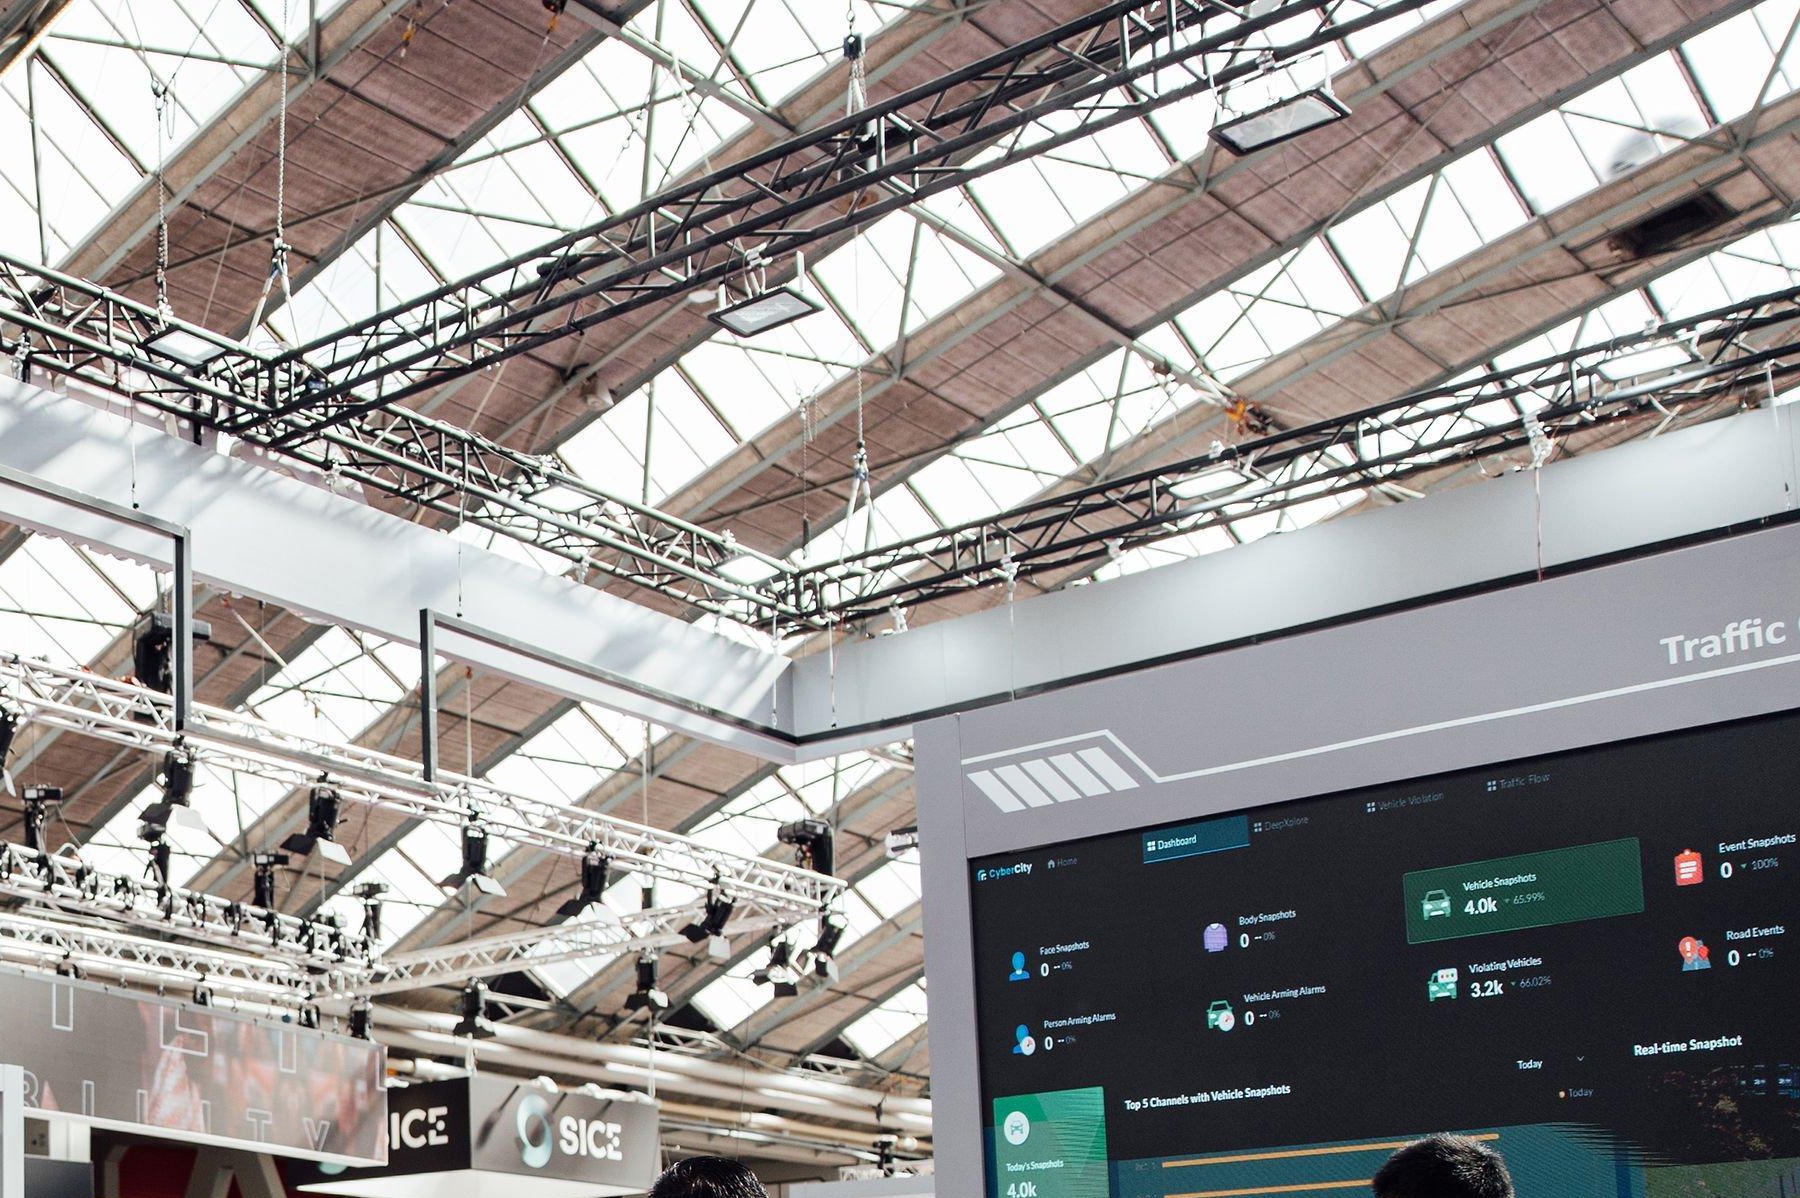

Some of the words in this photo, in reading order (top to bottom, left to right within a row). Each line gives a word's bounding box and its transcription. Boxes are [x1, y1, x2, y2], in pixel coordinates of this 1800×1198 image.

[1659, 618, 1787, 664] Traffic
[1499, 777, 1526, 790] Traffic
[1528, 773, 1551, 785] Flow
[1378, 797, 1406, 811] Vehicle
[1407, 791, 1444, 807] Violation
[1157, 834, 1197, 850] Dashboard
[1719, 841, 1747, 854] Event
[1747, 833, 1797, 849] Snapshots
[989, 862, 1032, 879] CyberCity
[1057, 857, 1078, 867] Home
[1720, 861, 1733, 879] 0
[1751, 857, 1779, 871] 100%
[1463, 878, 1492, 892] Vehicle
[1493, 872, 1537, 889] Snapshots
[1464, 896, 1498, 916] 4.0k
[1513, 891, 1546, 906] 65.99%
[1239, 915, 1258, 928] Body
[1258, 909, 1297, 925] Snapshots
[1239, 933, 1250, 948] 0
[1726, 928, 1751, 941] Road
[1751, 924, 1785, 938] Events
[1039, 944, 1055, 956] Face
[1055, 939, 1090, 954] Snapshots
[1468, 959, 1507, 975] Violating
[1507, 955, 1542, 969] Vehicles
[1727, 949, 1740, 967] 0
[1040, 962, 1049, 977] 0
[1243, 991, 1270, 1004] Vehicle
[1270, 987, 1299, 1001] Arming
[1299, 984, 1326, 996] Alarms
[1470, 979, 1504, 999] 3.2k
[1519, 975, 1552, 989] 66.02%
[1043, 1017, 1068, 1029] Person
[1067, 1014, 1092, 1027] Arming
[1092, 1010, 1116, 1023] Alarms
[1244, 1011, 1254, 1026] 0
[1044, 1036, 1053, 1050] 0
[1634, 1040, 1688, 1057] Real-time
[1689, 1034, 1743, 1054] Snapshot
[1517, 1058, 1543, 1072] Today
[1124, 1098, 1141, 1111] Top
[1142, 1098, 1149, 1108] 5
[1149, 1093, 1189, 1108] Channels
[1190, 1091, 1210, 1103] with
[1210, 1087, 1243, 1101] Vehicle
[1244, 1084, 1291, 1100] Snapshots
[1568, 1086, 1594, 1099] Today
[386, 1105, 449, 1150] ICE
[559, 1115, 623, 1161] SICE
[1006, 1161, 1030, 1173] Today's
[1030, 1158, 1064, 1171] Snapshots
[1006, 1181, 1037, 1198] 4.0k
